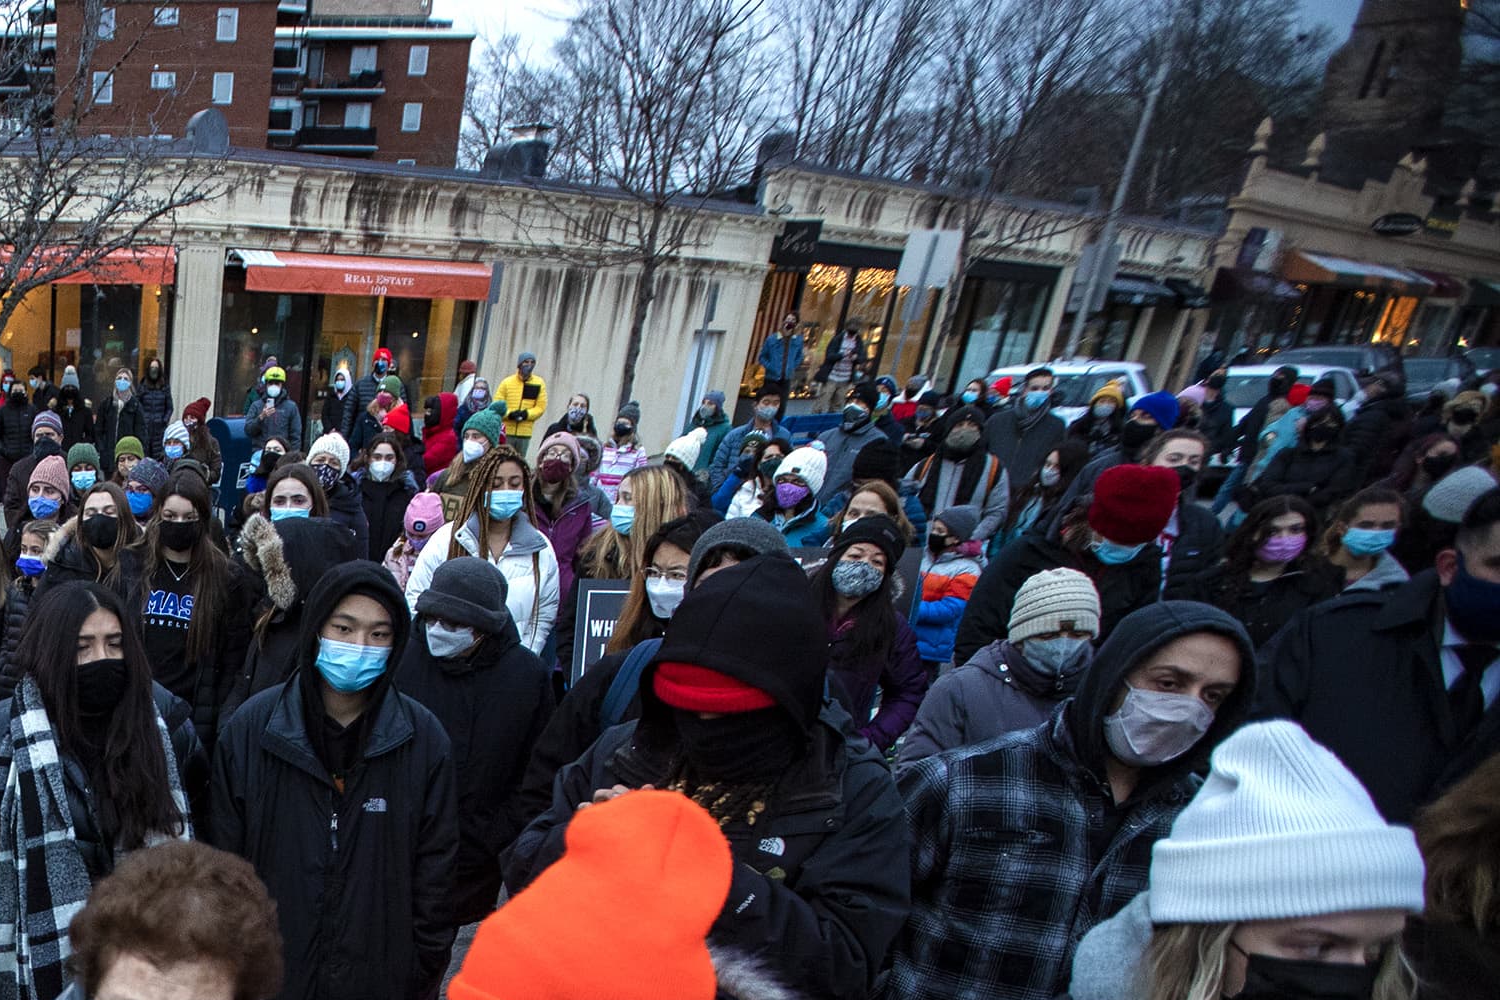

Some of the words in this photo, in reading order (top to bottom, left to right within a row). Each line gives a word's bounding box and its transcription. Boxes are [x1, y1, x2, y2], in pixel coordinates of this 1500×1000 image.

[344, 273, 373, 284] REAL
[376, 275, 415, 286] ESTATE
[143, 589, 197, 621] MAS
[145, 617, 190, 630] OWELL
[590, 619, 618, 638] WH
